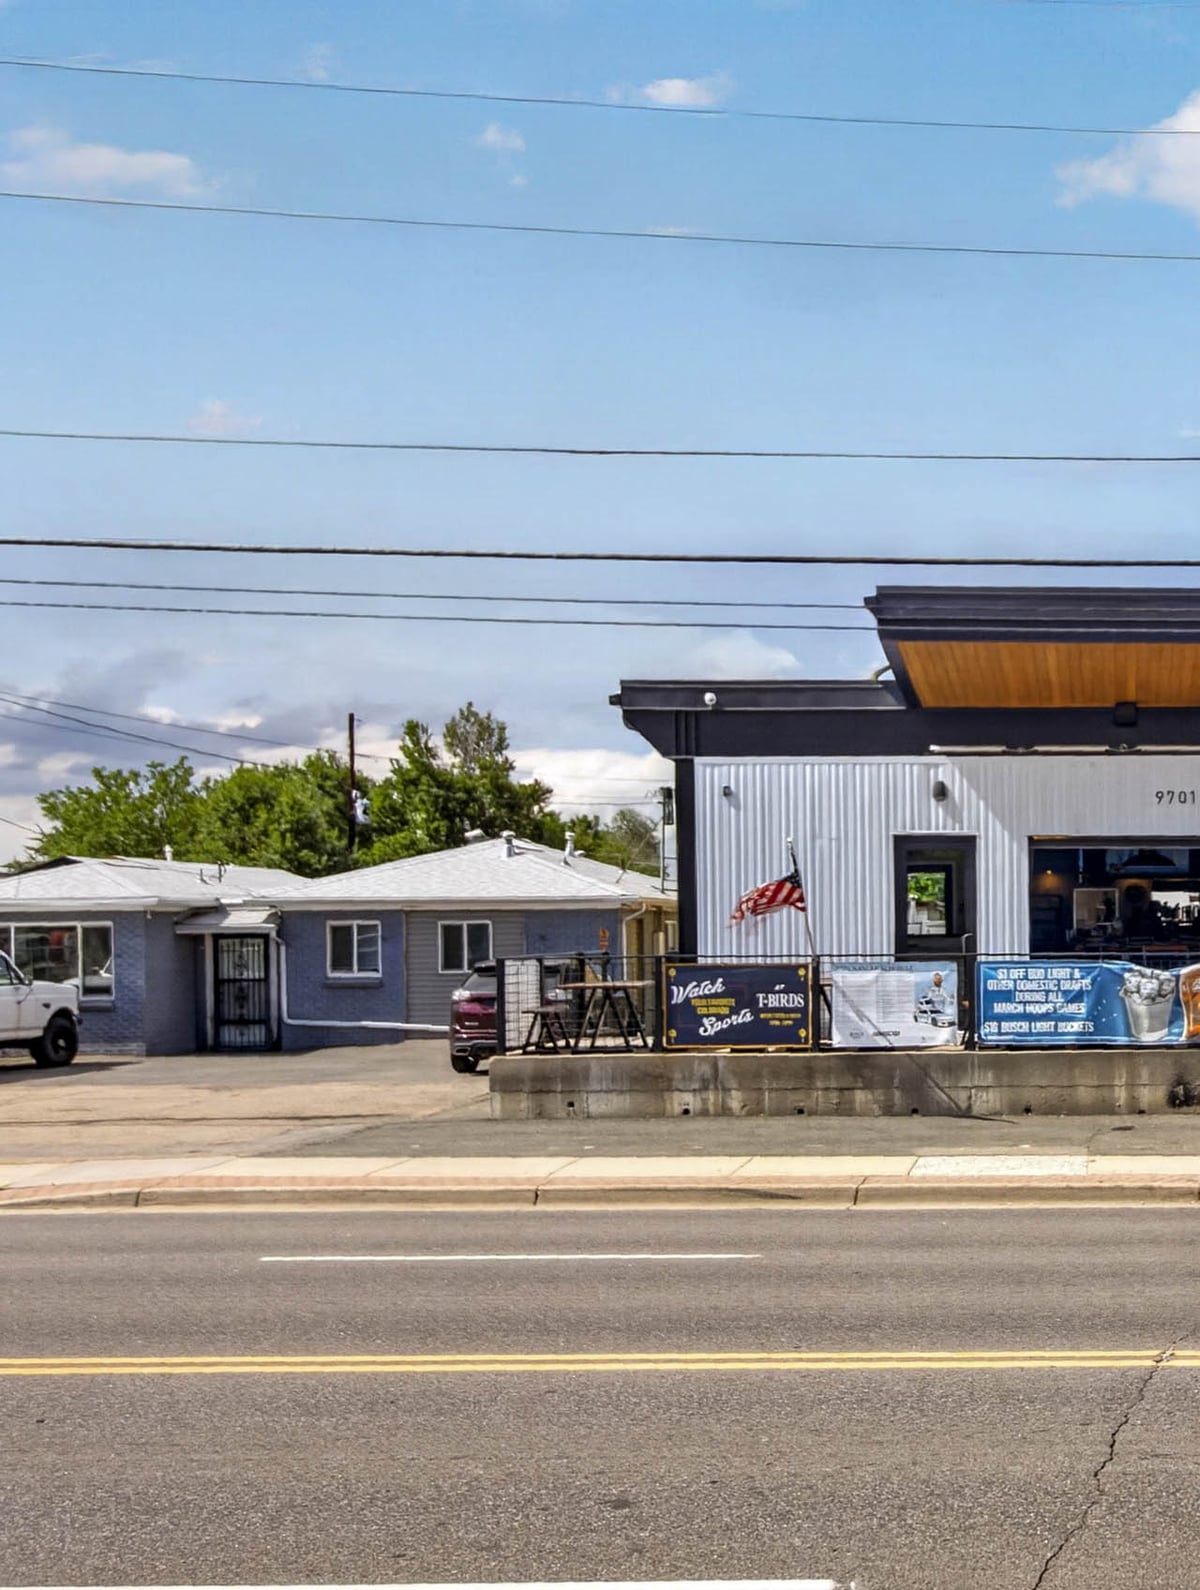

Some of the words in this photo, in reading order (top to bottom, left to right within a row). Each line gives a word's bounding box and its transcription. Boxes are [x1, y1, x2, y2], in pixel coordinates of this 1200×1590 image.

[1155, 790, 1196, 805] 9701
[1010, 968, 1026, 979] OFF
[1028, 968, 1045, 979] BUD
[1047, 968, 1071, 979] LIGHT
[987, 980, 1014, 990] OTHER
[1016, 980, 1058, 990] DOMESTIC
[1060, 979, 1092, 990] DRAFTS
[671, 977, 726, 1004] Watch
[1015, 991, 1046, 1002] DURING
[1048, 991, 1065, 1002] ALL
[993, 1002, 1024, 1013] MARCH
[1025, 1002, 1054, 1013] HOOPS
[1056, 1002, 1085, 1013] GAMES
[699, 1008, 754, 1036] Sports
[1001, 1021, 1029, 1033] BUSCH
[1031, 1021, 1056, 1033] LIGHT
[1058, 1021, 1094, 1032] BUCKETS
